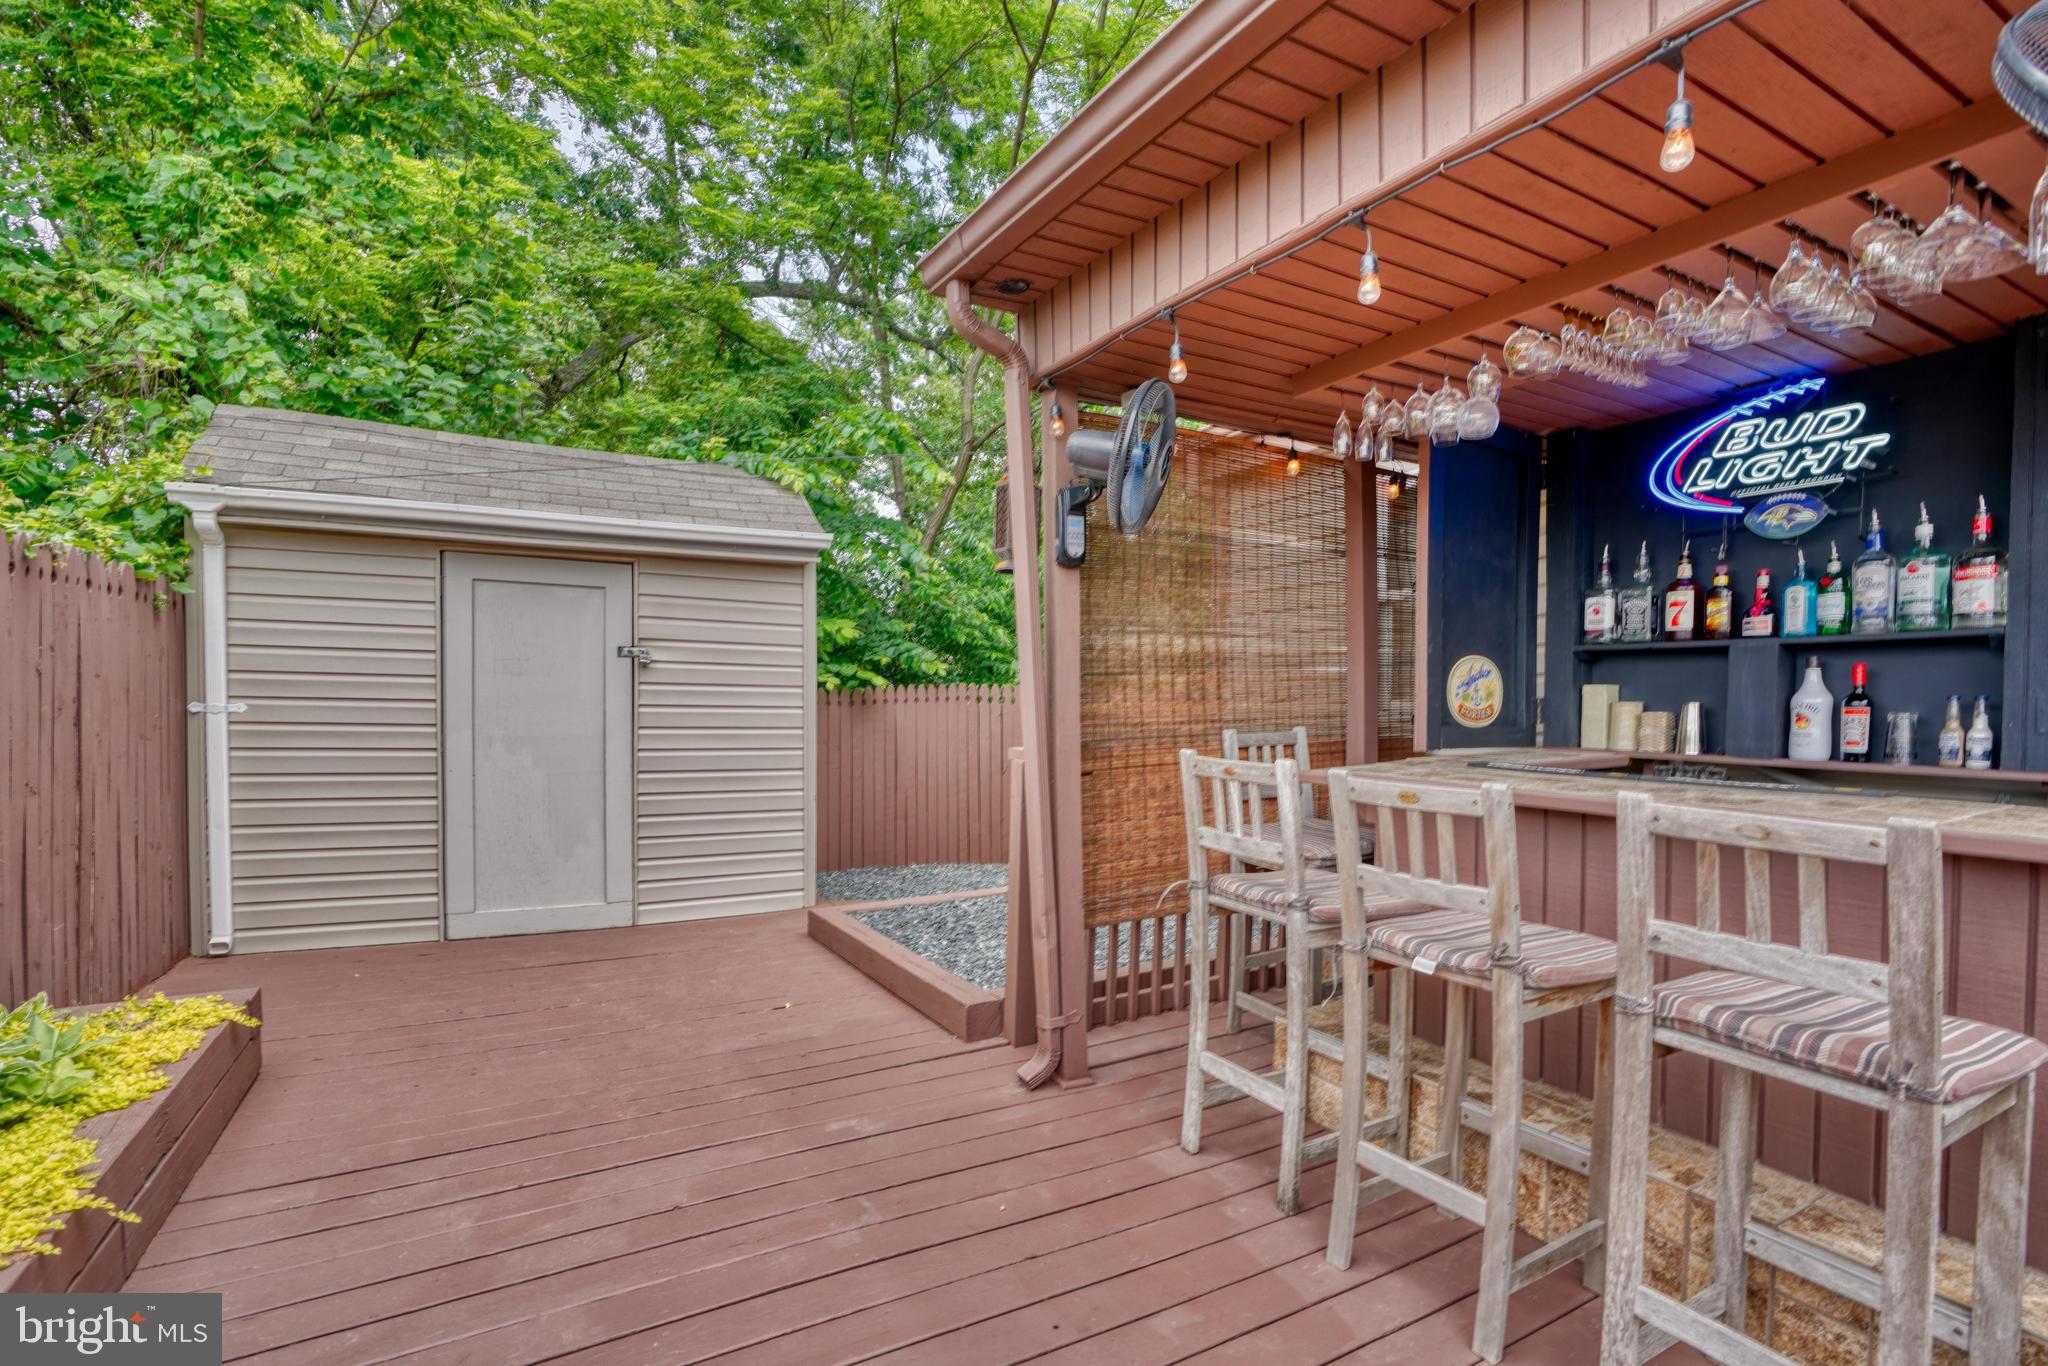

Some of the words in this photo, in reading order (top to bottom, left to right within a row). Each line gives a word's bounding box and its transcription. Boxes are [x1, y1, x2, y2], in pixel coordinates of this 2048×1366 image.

[1713, 402, 1866, 458] BUD
[1683, 433, 1891, 493] LIGHT
[1668, 600, 1689, 627] 7
